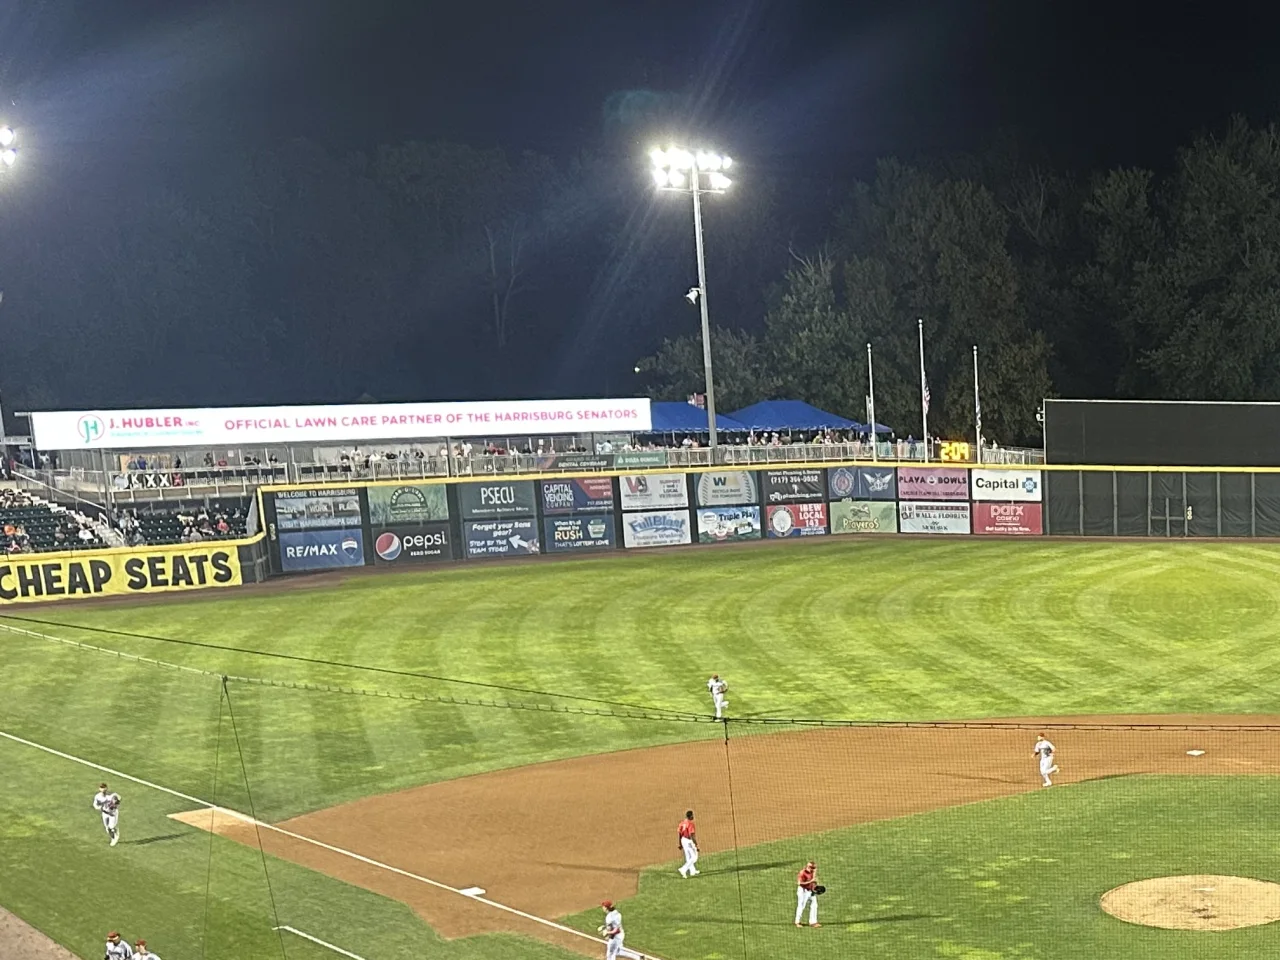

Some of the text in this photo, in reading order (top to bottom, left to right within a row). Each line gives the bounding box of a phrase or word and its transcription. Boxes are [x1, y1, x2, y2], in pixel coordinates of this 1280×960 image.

[110, 418, 119, 429] J.
[122, 416, 183, 429] HUBLER
[224, 408, 638, 430] OFFICIAL LAWN CARE PARTNER OF THE HARRISBURG SENATORS
[941, 442, 969, 460] 2:09
[899, 476, 967, 484] PLAYA BOWLS
[975, 477, 1019, 491] Capital
[277, 491, 307, 499] WELCOME
[318, 489, 356, 497] HARRISBURG
[544, 484, 573, 494] CAPITAL
[480, 486, 515, 505] PSECU
[544, 492, 574, 502] VENDING
[719, 513, 740, 521] Triple
[741, 511, 757, 520] Play
[799, 511, 824, 519] LOCAL
[991, 505, 1024, 518] parx
[472, 522, 496, 531] Forget
[498, 522, 513, 531] your
[805, 519, 819, 527] 143
[493, 529, 512, 538] gear?
[555, 530, 583, 541] RUSH
[402, 530, 447, 551] pepsi
[286, 543, 338, 558] RE/MAX
[0, 551, 233, 600] CHEAP SEATS
